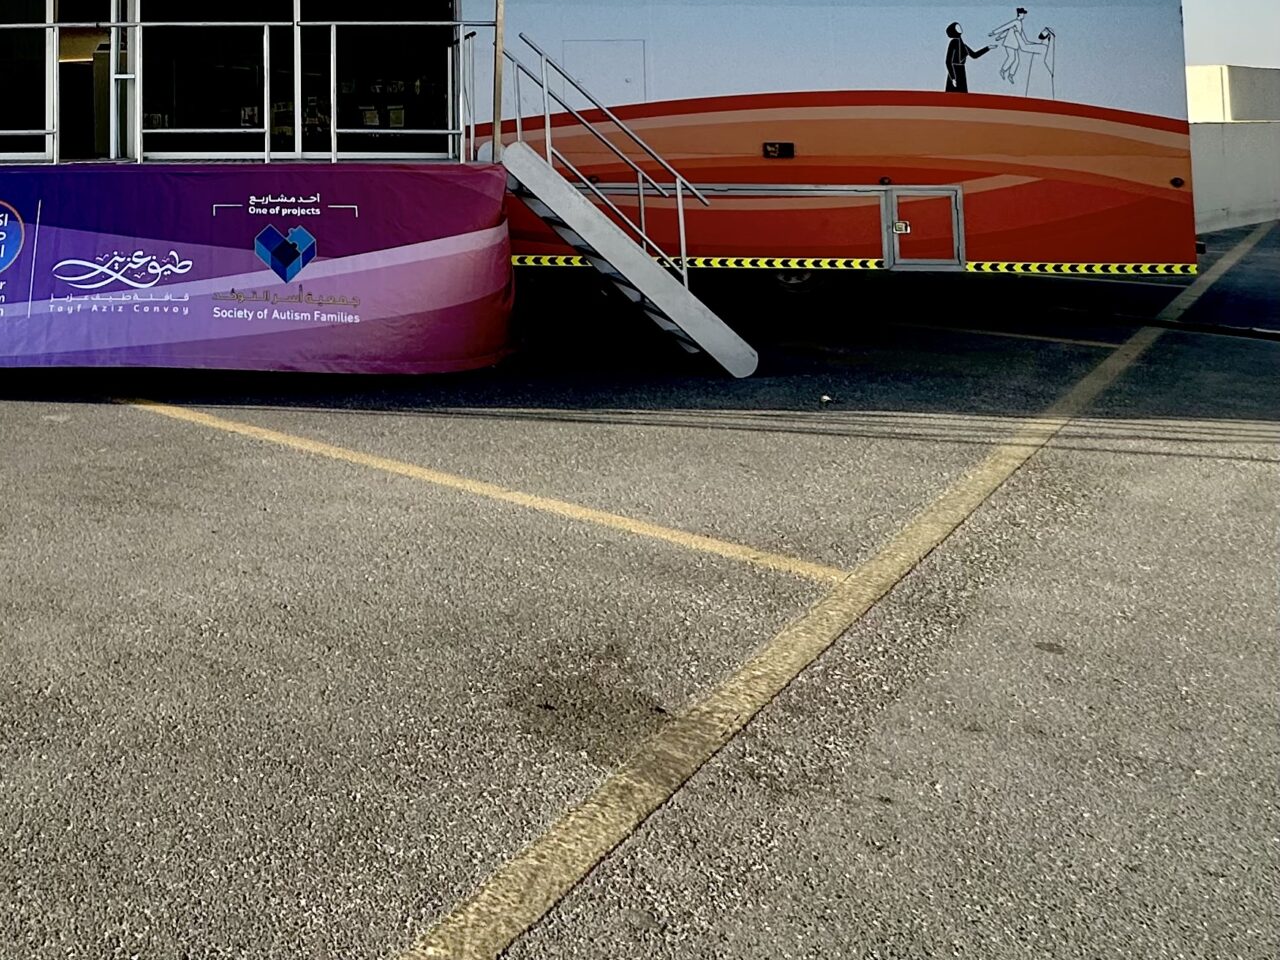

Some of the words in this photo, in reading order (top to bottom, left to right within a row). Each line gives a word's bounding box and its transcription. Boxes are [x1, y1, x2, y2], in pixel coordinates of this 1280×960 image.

[249, 194, 296, 205] مشاريع
[297, 192, 320, 203] أحد
[248, 206, 268, 214] One
[269, 206, 280, 214] of
[282, 206, 321, 216] projects
[49, 304, 82, 315] Tayf
[92, 304, 123, 312] Aziz
[133, 304, 189, 315] Convoy
[213, 306, 256, 321] Society
[257, 308, 268, 319] of
[272, 309, 311, 321] Autism
[314, 311, 360, 323] Families
